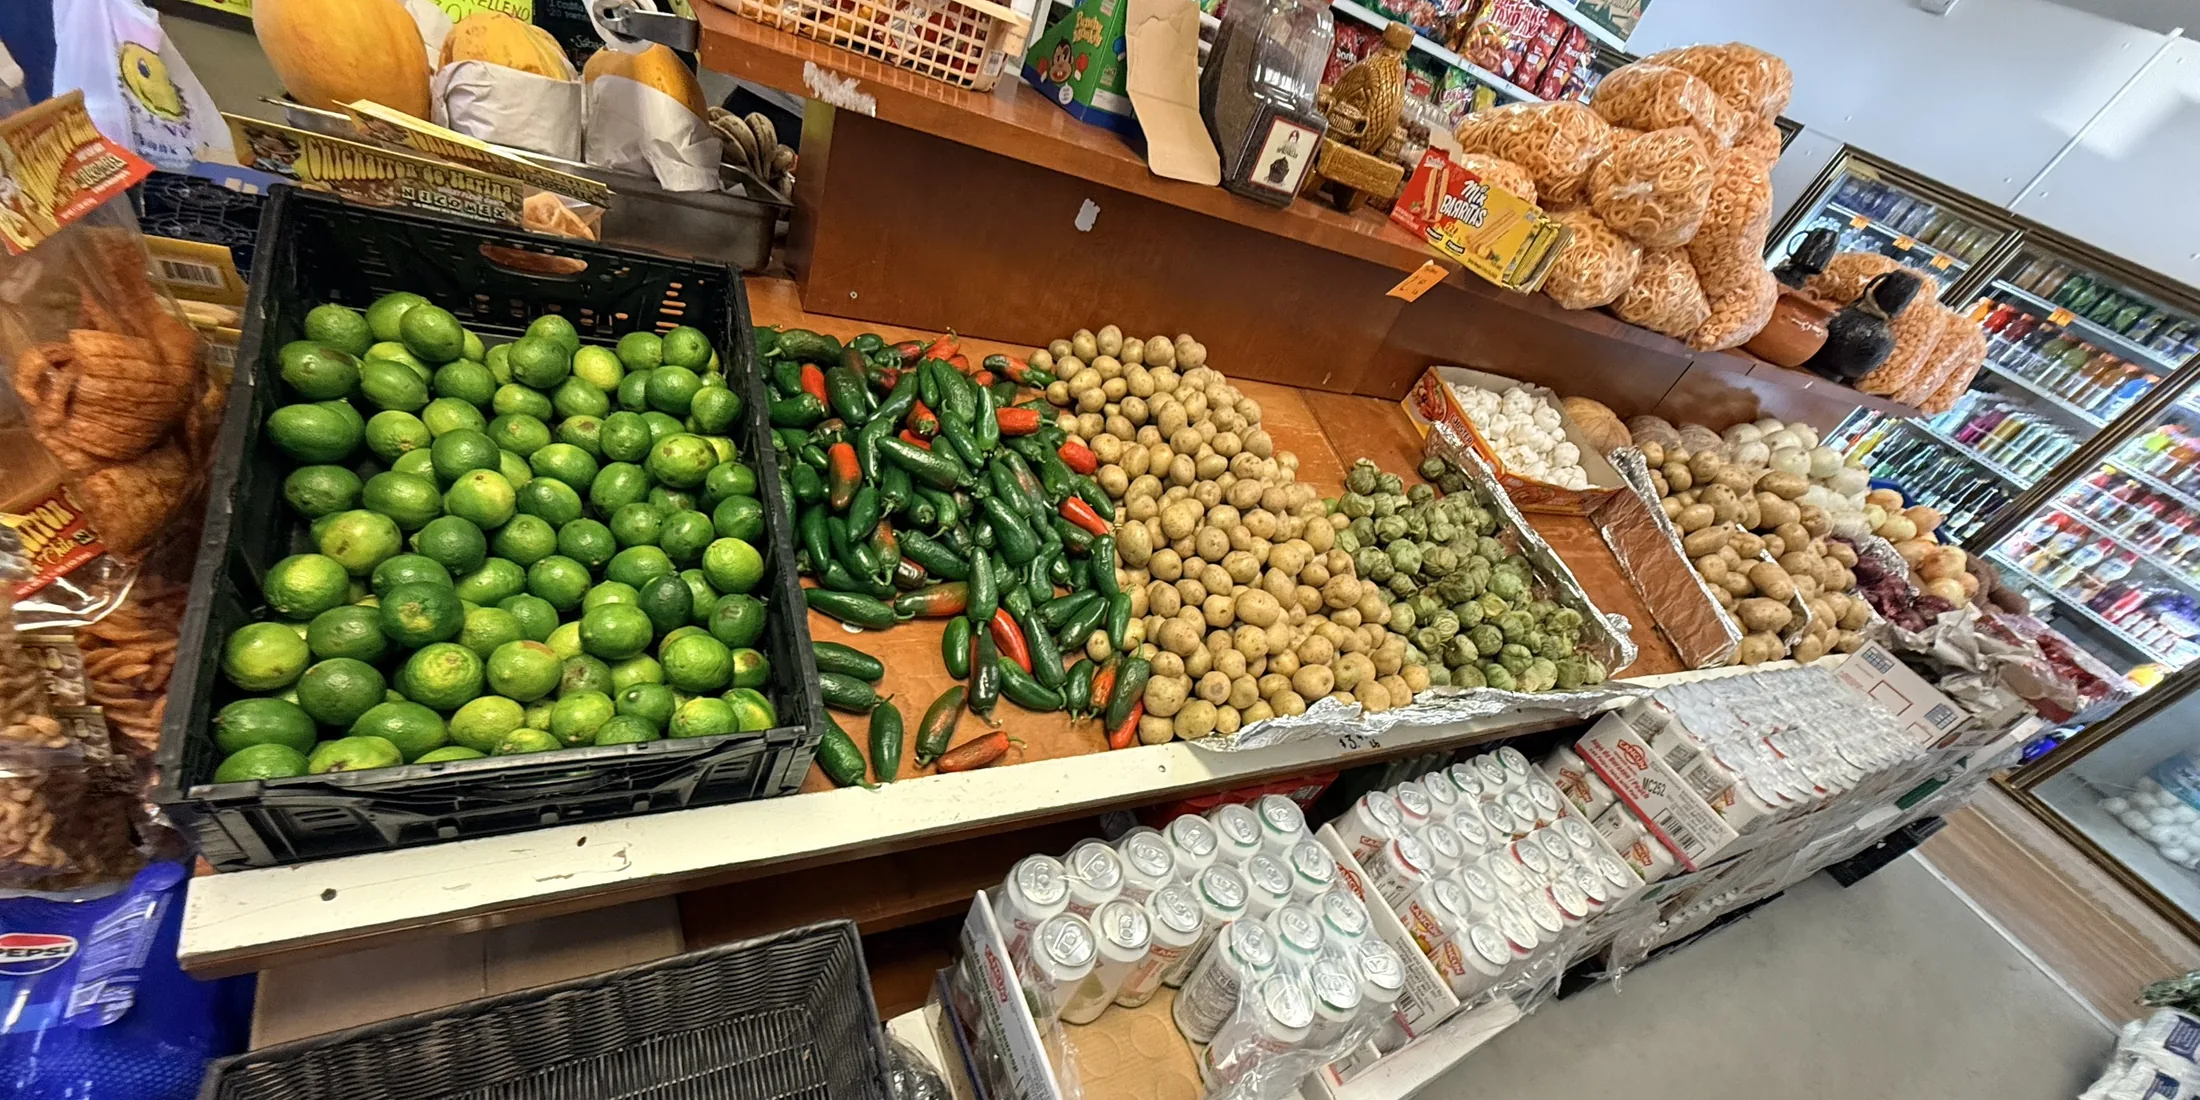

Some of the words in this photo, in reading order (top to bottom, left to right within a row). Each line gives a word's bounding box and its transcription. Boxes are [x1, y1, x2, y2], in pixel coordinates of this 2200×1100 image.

[305, 138, 418, 181] Chicharron
[423, 165, 446, 186] de
[449, 170, 514, 203] Harina
[402, 186, 507, 220] NICOMEX
[1462, 180, 1489, 206] Mix
[1618, 739, 1648, 770] CANCUN
[1409, 901, 1444, 937] CANCUN
[5, 946, 72, 959] EPSI
[1443, 940, 1466, 976] ANCUN
